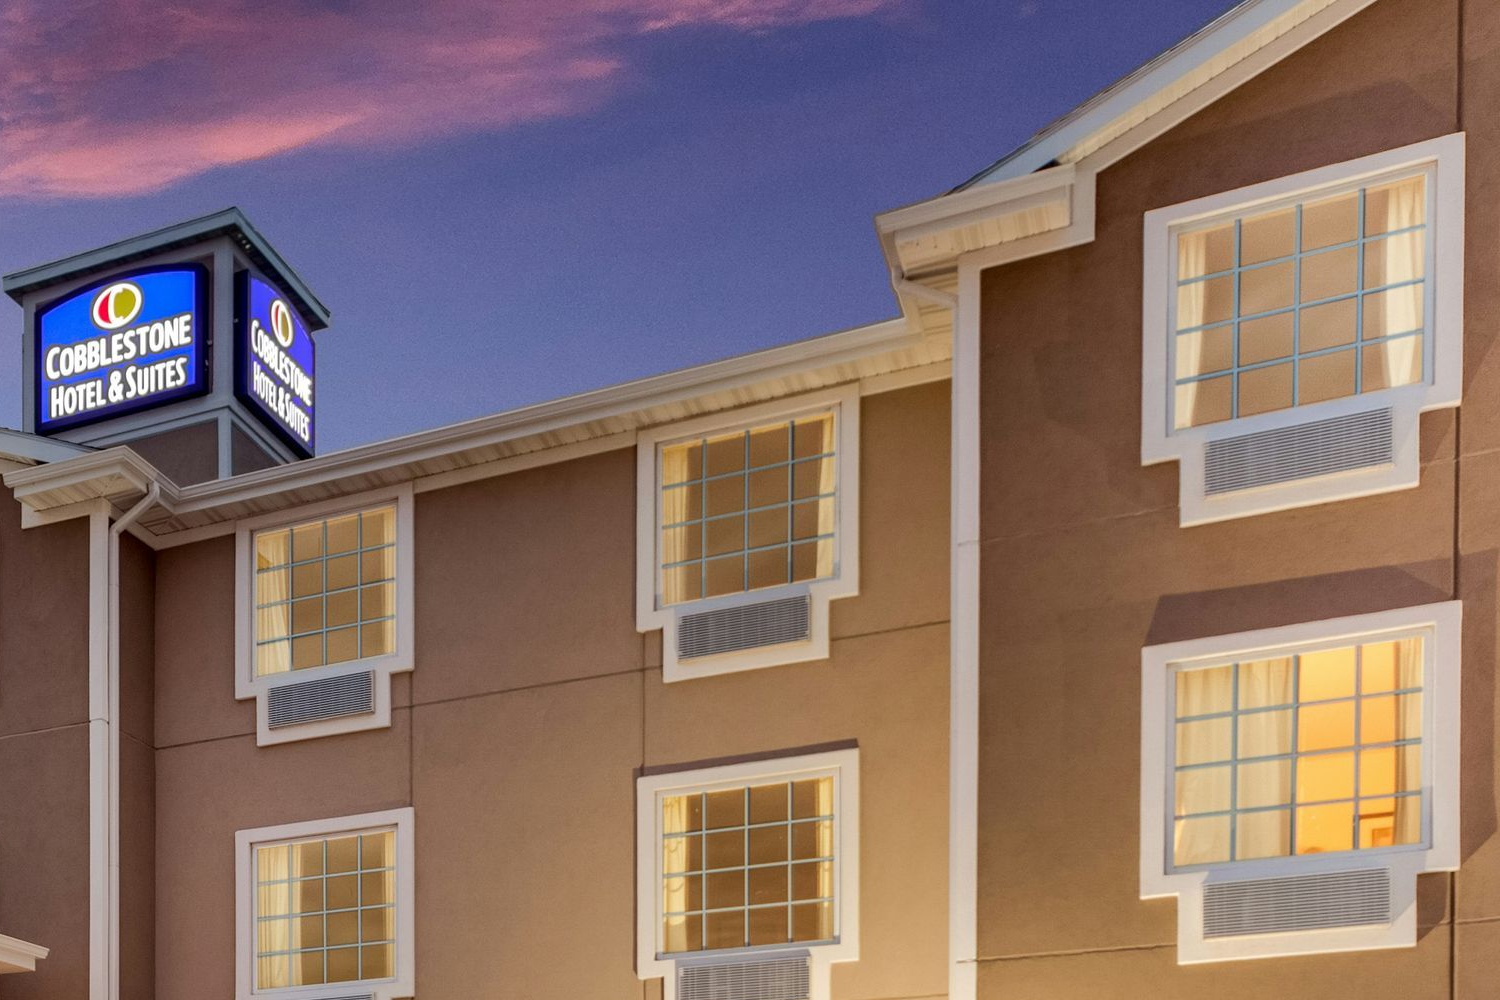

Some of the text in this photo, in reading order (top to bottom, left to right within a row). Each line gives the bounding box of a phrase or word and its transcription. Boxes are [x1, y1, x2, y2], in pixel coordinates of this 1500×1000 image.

[46, 314, 192, 380] COBBLESTONE
[251, 319, 312, 407] COBBLESTONE
[51, 357, 188, 418] HOTEL & SUITES
[253, 360, 310, 442] HOTEL & SUITES
